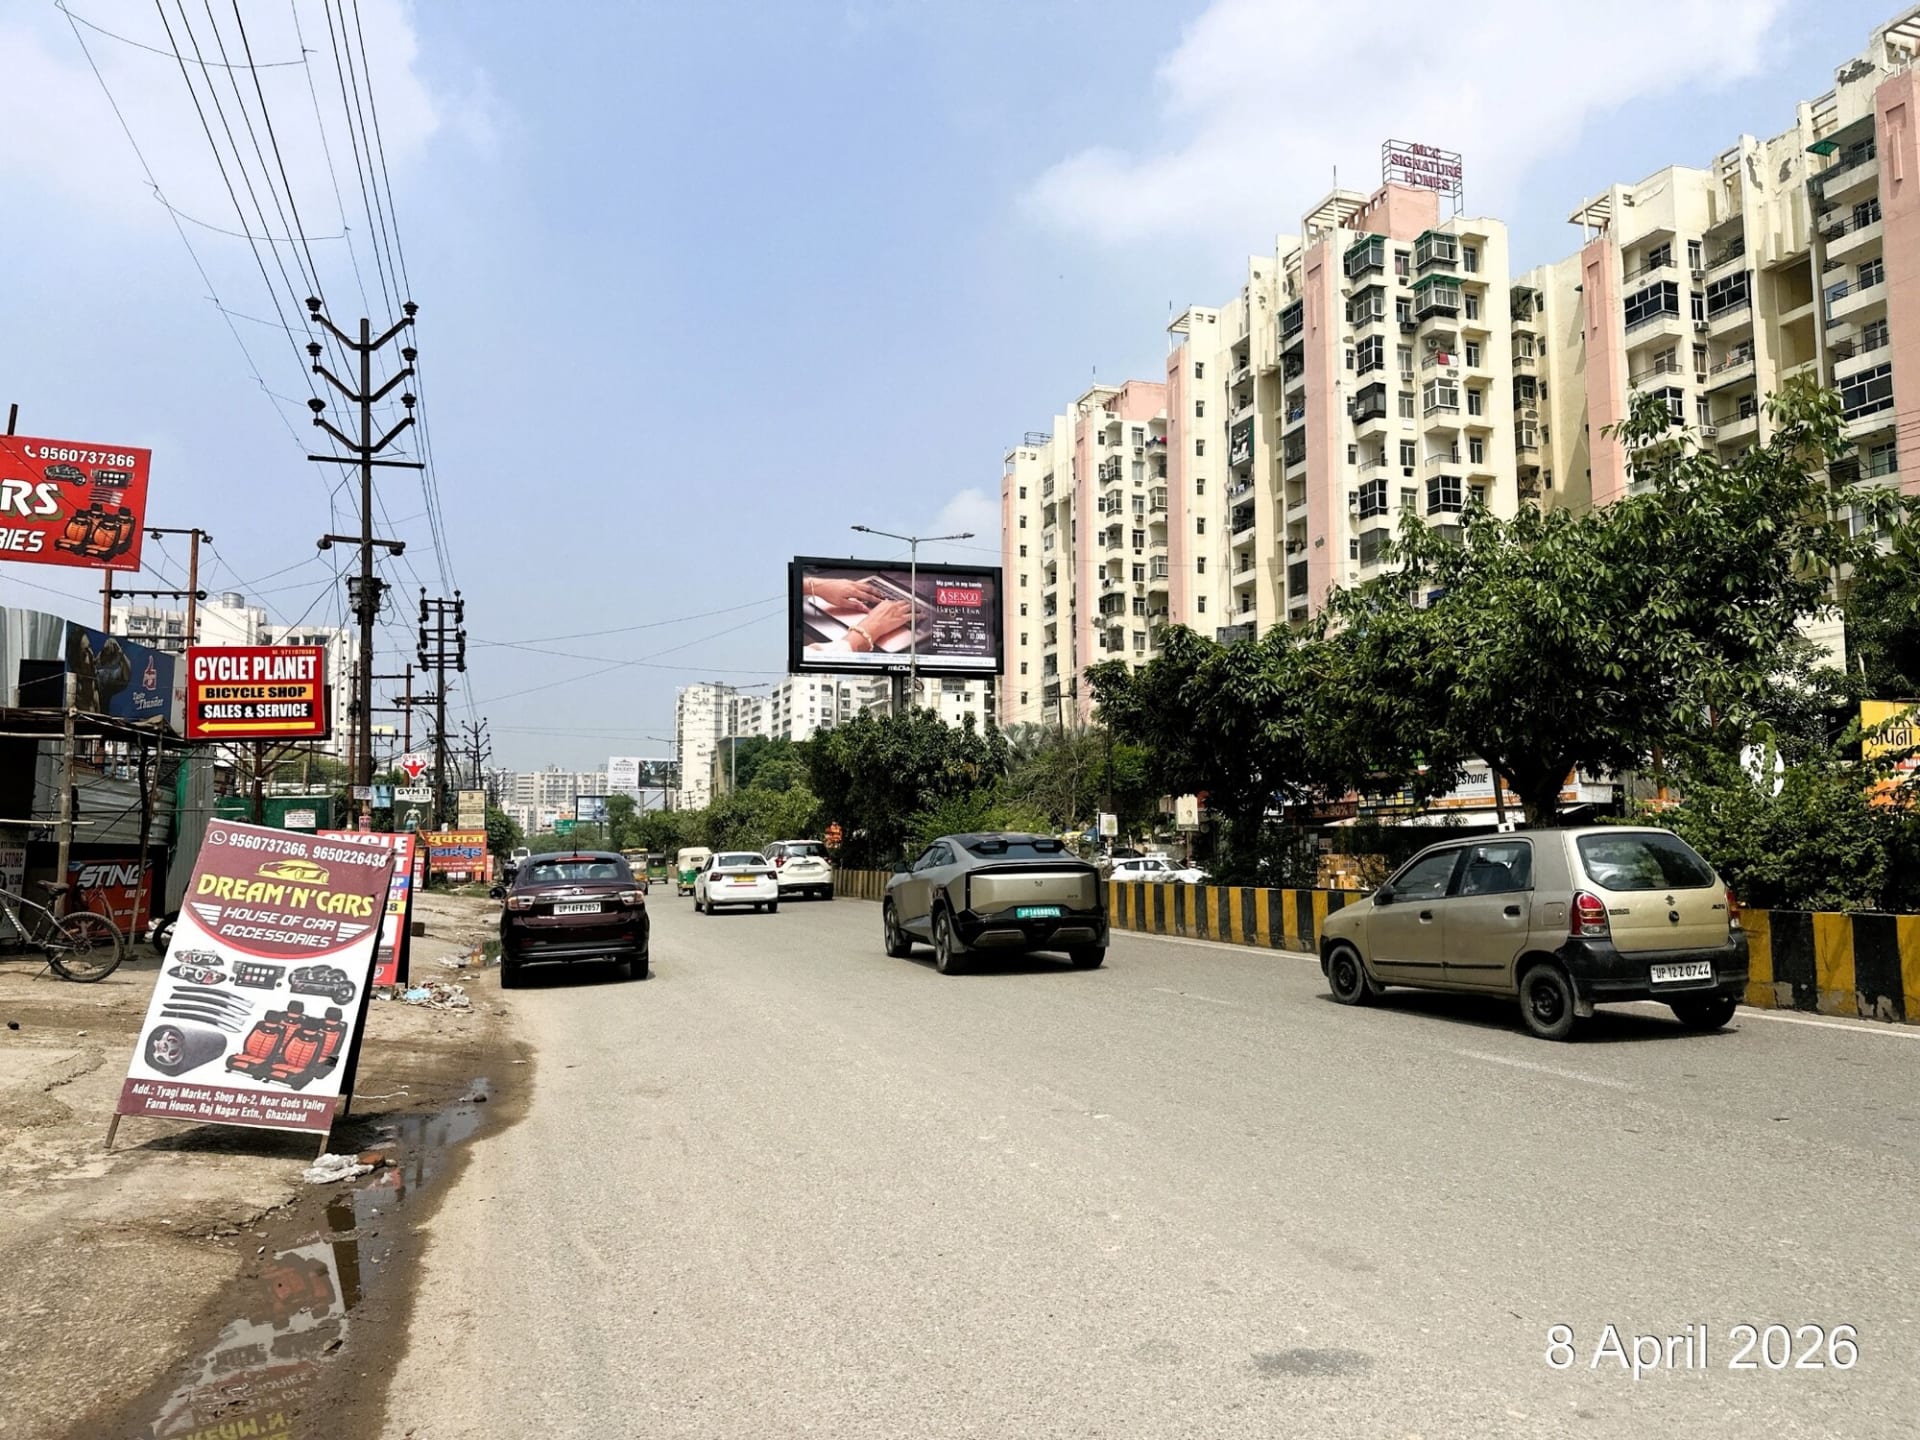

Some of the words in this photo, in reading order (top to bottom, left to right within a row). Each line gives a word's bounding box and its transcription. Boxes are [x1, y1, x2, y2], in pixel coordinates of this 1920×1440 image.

[1391, 153, 1462, 178] SIGNATURE
[1404, 171, 1450, 190] HOMES
[40, 446, 135, 468] 9560737366
[948, 591, 978, 601] SENCO
[194, 656, 249, 681] CYCLE
[253, 656, 317, 680] PLANET
[205, 687, 265, 698] BICYCLE
[268, 686, 307, 698] SHOP
[204, 704, 242, 718] SALES
[244, 706, 254, 718] &
[256, 703, 308, 718] SERVICE
[229, 833, 309, 858] 9560737366,
[312, 846, 387, 868] 9650226438
[223, 907, 279, 925] HOUSE
[280, 914, 300, 926] OF
[303, 918, 337, 931] CAR
[220, 924, 332, 948] ACCESSORIES
[132, 1083, 154, 1096] Add.:
[156, 1085, 179, 1099] Tyagi
[180, 1087, 212, 1101] Market,
[214, 1091, 235, 1104] Shop
[236, 1093, 257, 1106] No-2,
[260, 1095, 280, 1107] Near
[281, 1097, 301, 1109] Gods
[303, 1099, 327, 1112] Valley
[145, 1097, 168, 1110] Farm
[169, 1100, 197, 1113] House,
[199, 1103, 215, 1116] Raj
[216, 1105, 240, 1118] Nagar
[265, 1108, 308, 1122] Ghaziabad
